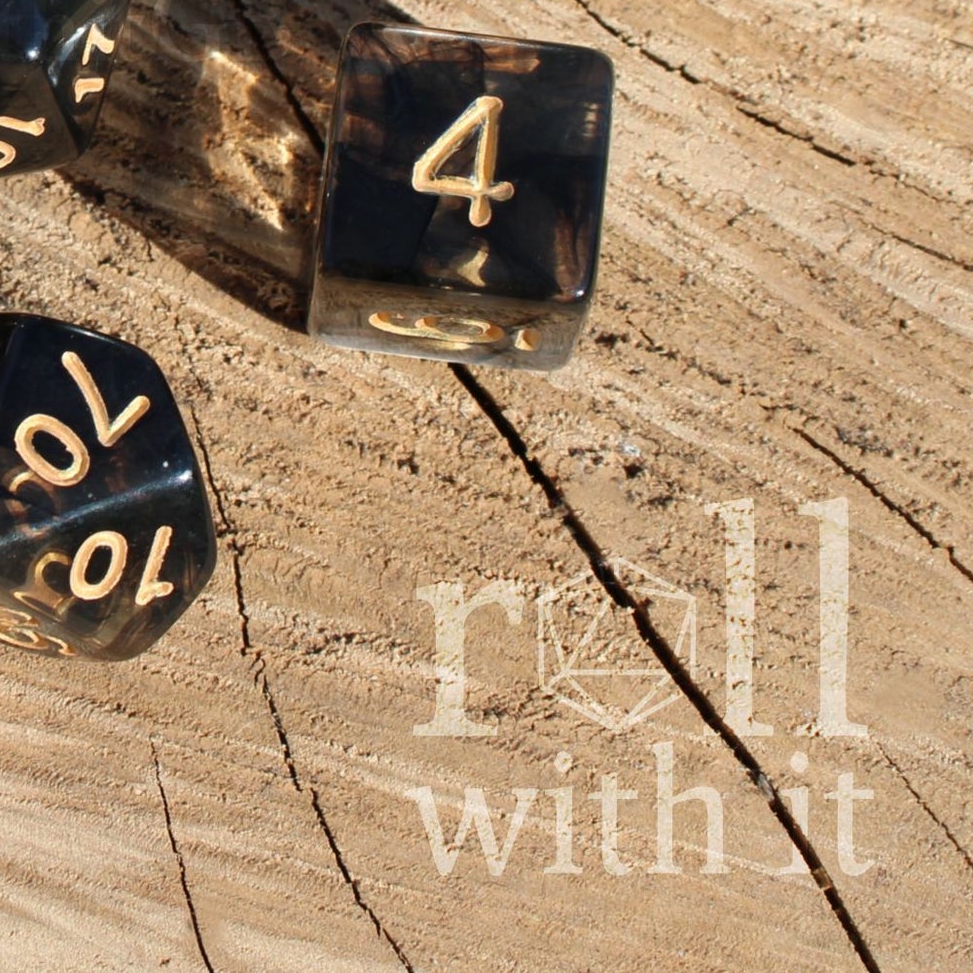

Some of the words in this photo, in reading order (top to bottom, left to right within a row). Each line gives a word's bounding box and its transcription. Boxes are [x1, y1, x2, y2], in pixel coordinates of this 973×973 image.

[412, 95, 515, 228] 4
[14, 350, 151, 488] 70
[69, 525, 175, 607] 10
